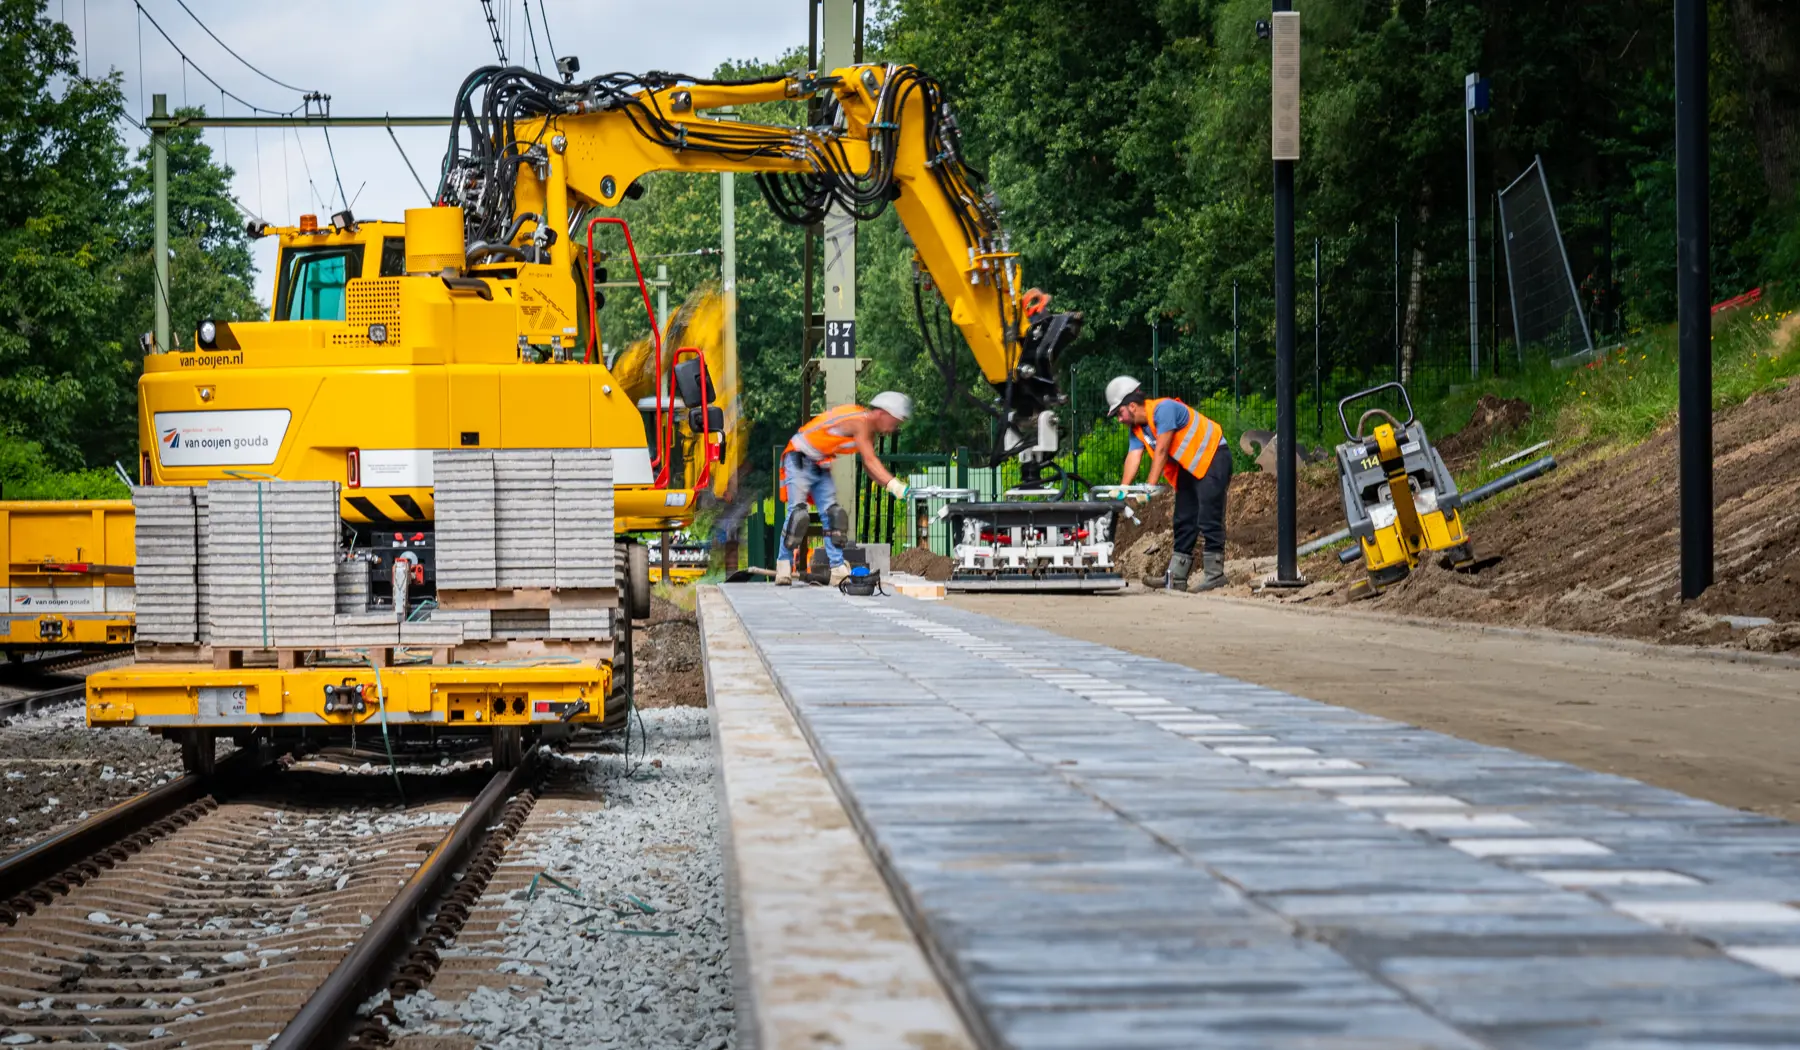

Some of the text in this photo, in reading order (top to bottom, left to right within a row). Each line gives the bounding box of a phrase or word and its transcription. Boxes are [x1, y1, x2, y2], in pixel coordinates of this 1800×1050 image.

[828, 322, 852, 337] 87
[829, 341, 850, 356] 11
[180, 352, 244, 369] van-ooijen.nl
[184, 435, 269, 450] van ooijen gouda
[1360, 455, 1380, 470] 114
[69, 598, 90, 606] gouda
